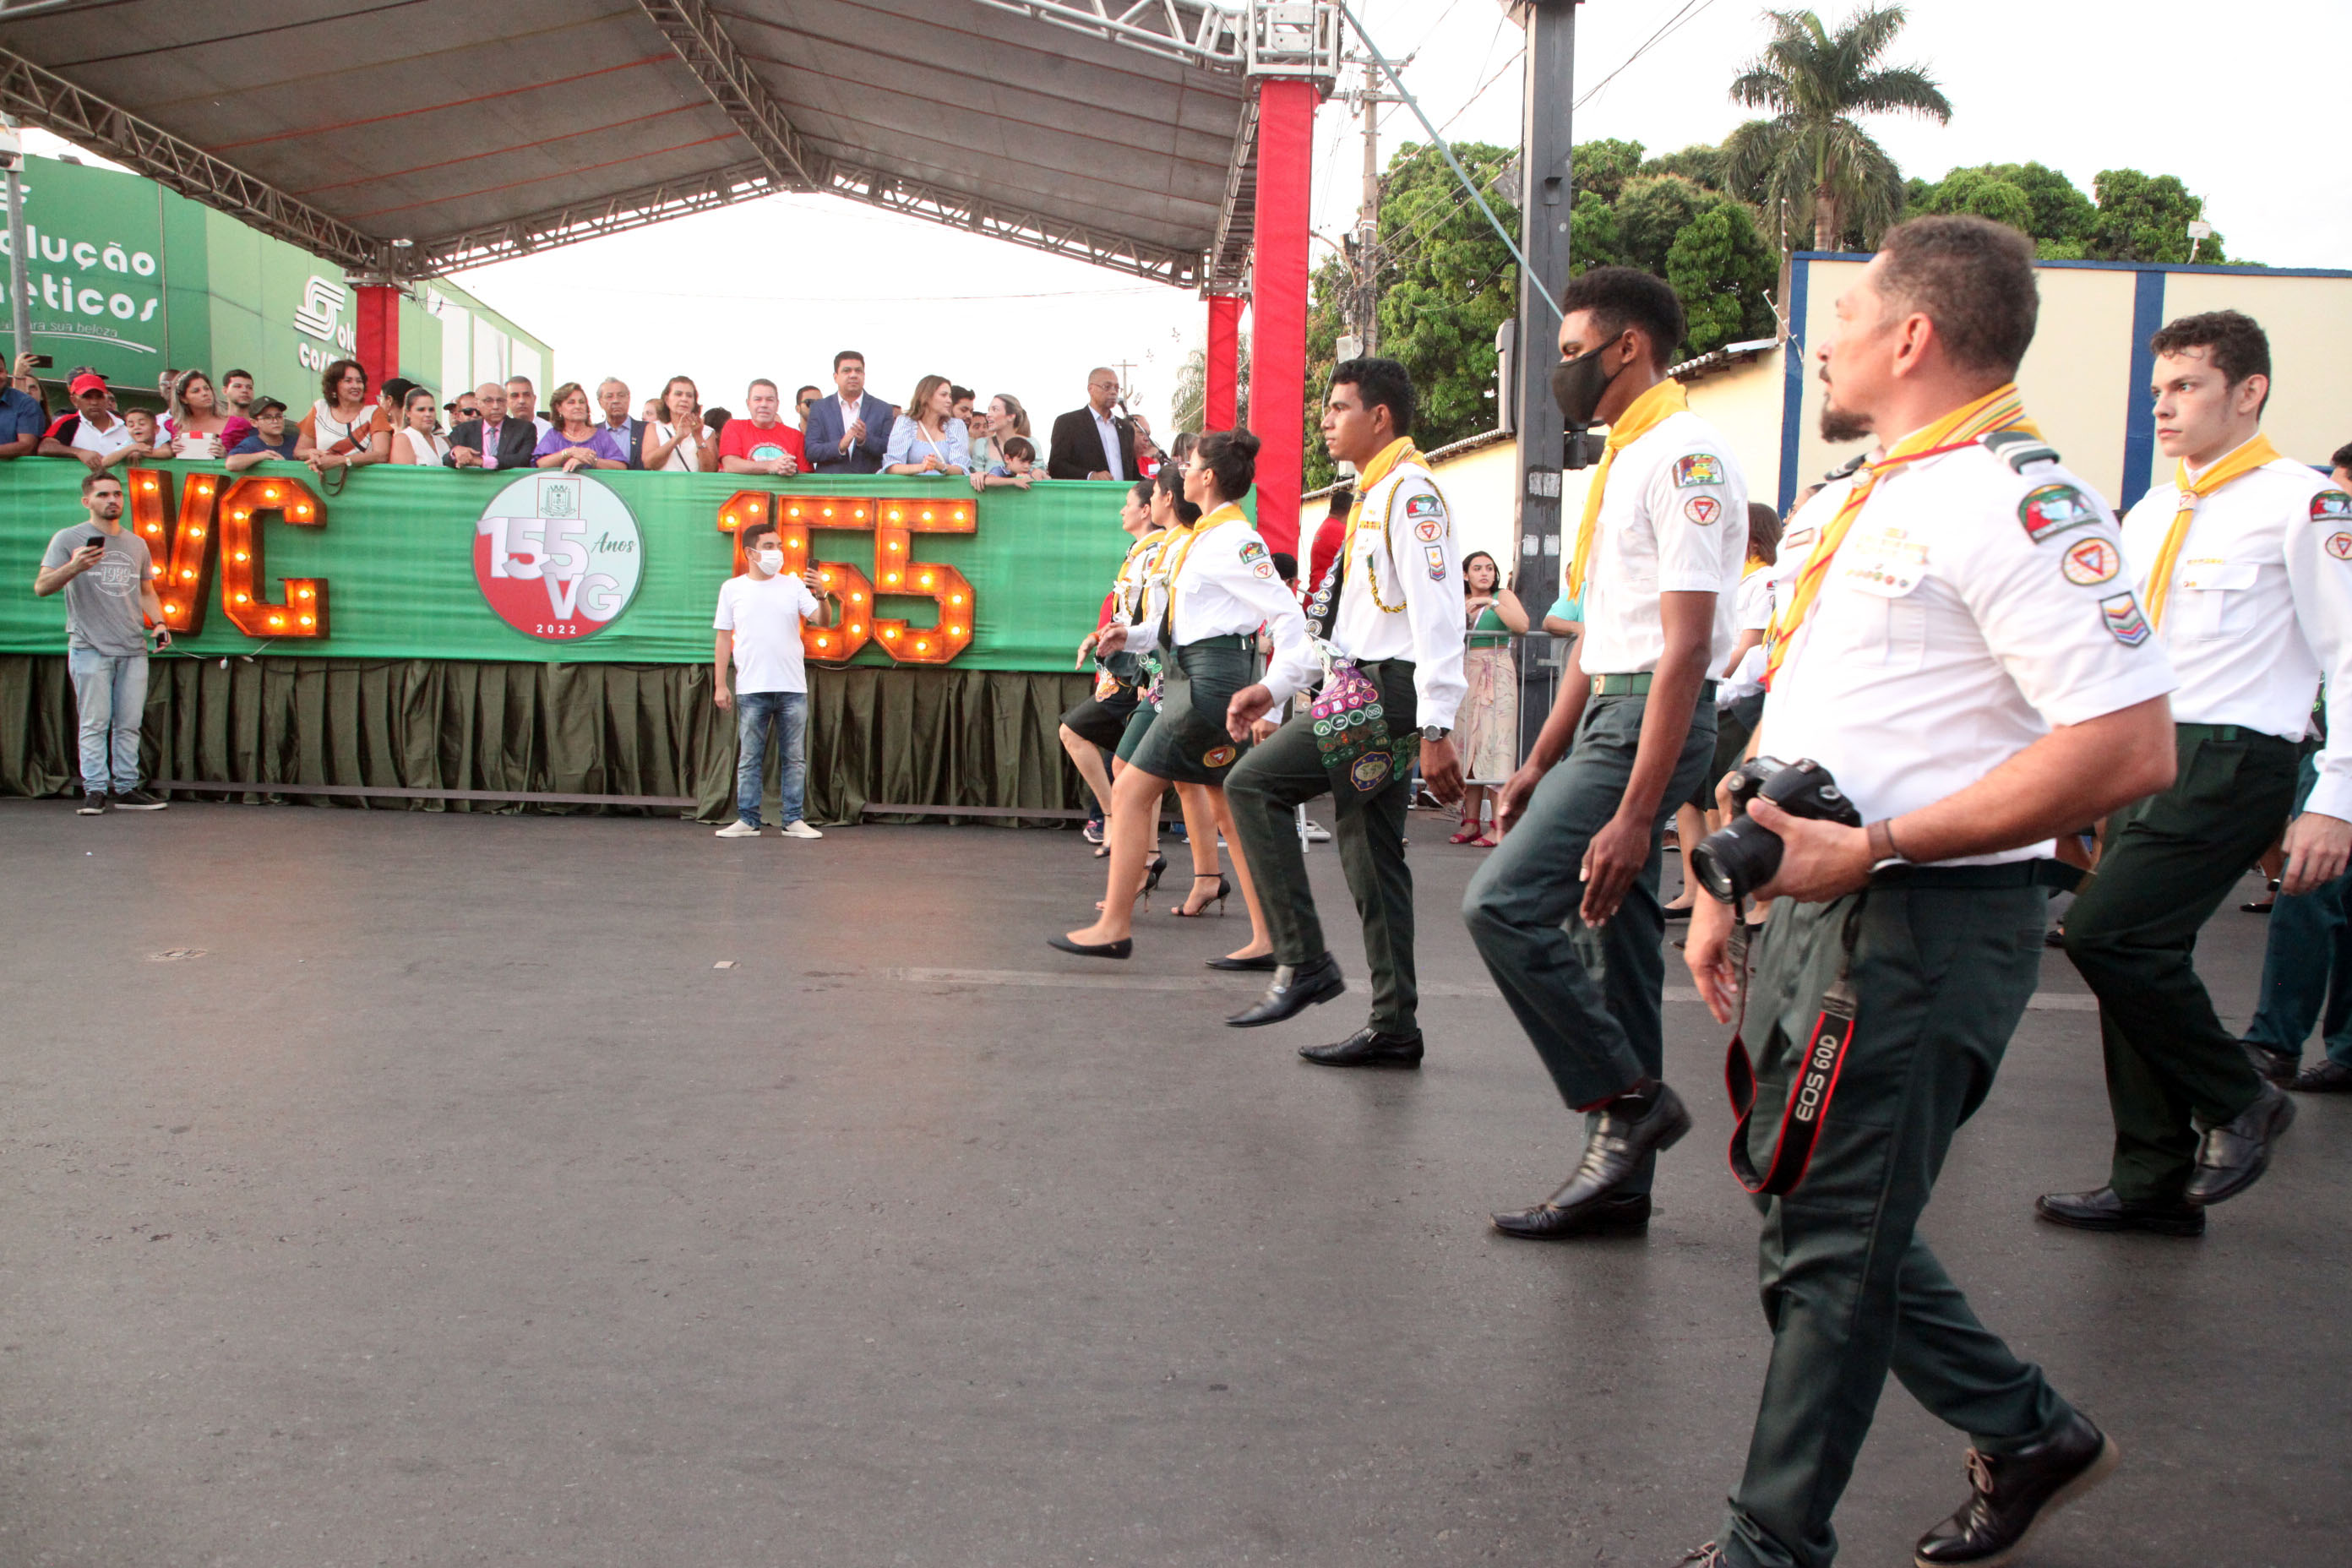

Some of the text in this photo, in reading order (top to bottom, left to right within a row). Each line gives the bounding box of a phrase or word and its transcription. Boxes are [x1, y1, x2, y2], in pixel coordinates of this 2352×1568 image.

[51, 321, 73, 332] sua
[77, 322, 118, 338] beleza
[476, 517, 636, 581] 155 Anos
[542, 573, 623, 622] VG
[536, 624, 576, 634] 2022
[1795, 1035, 1838, 1121] EOS 60D
